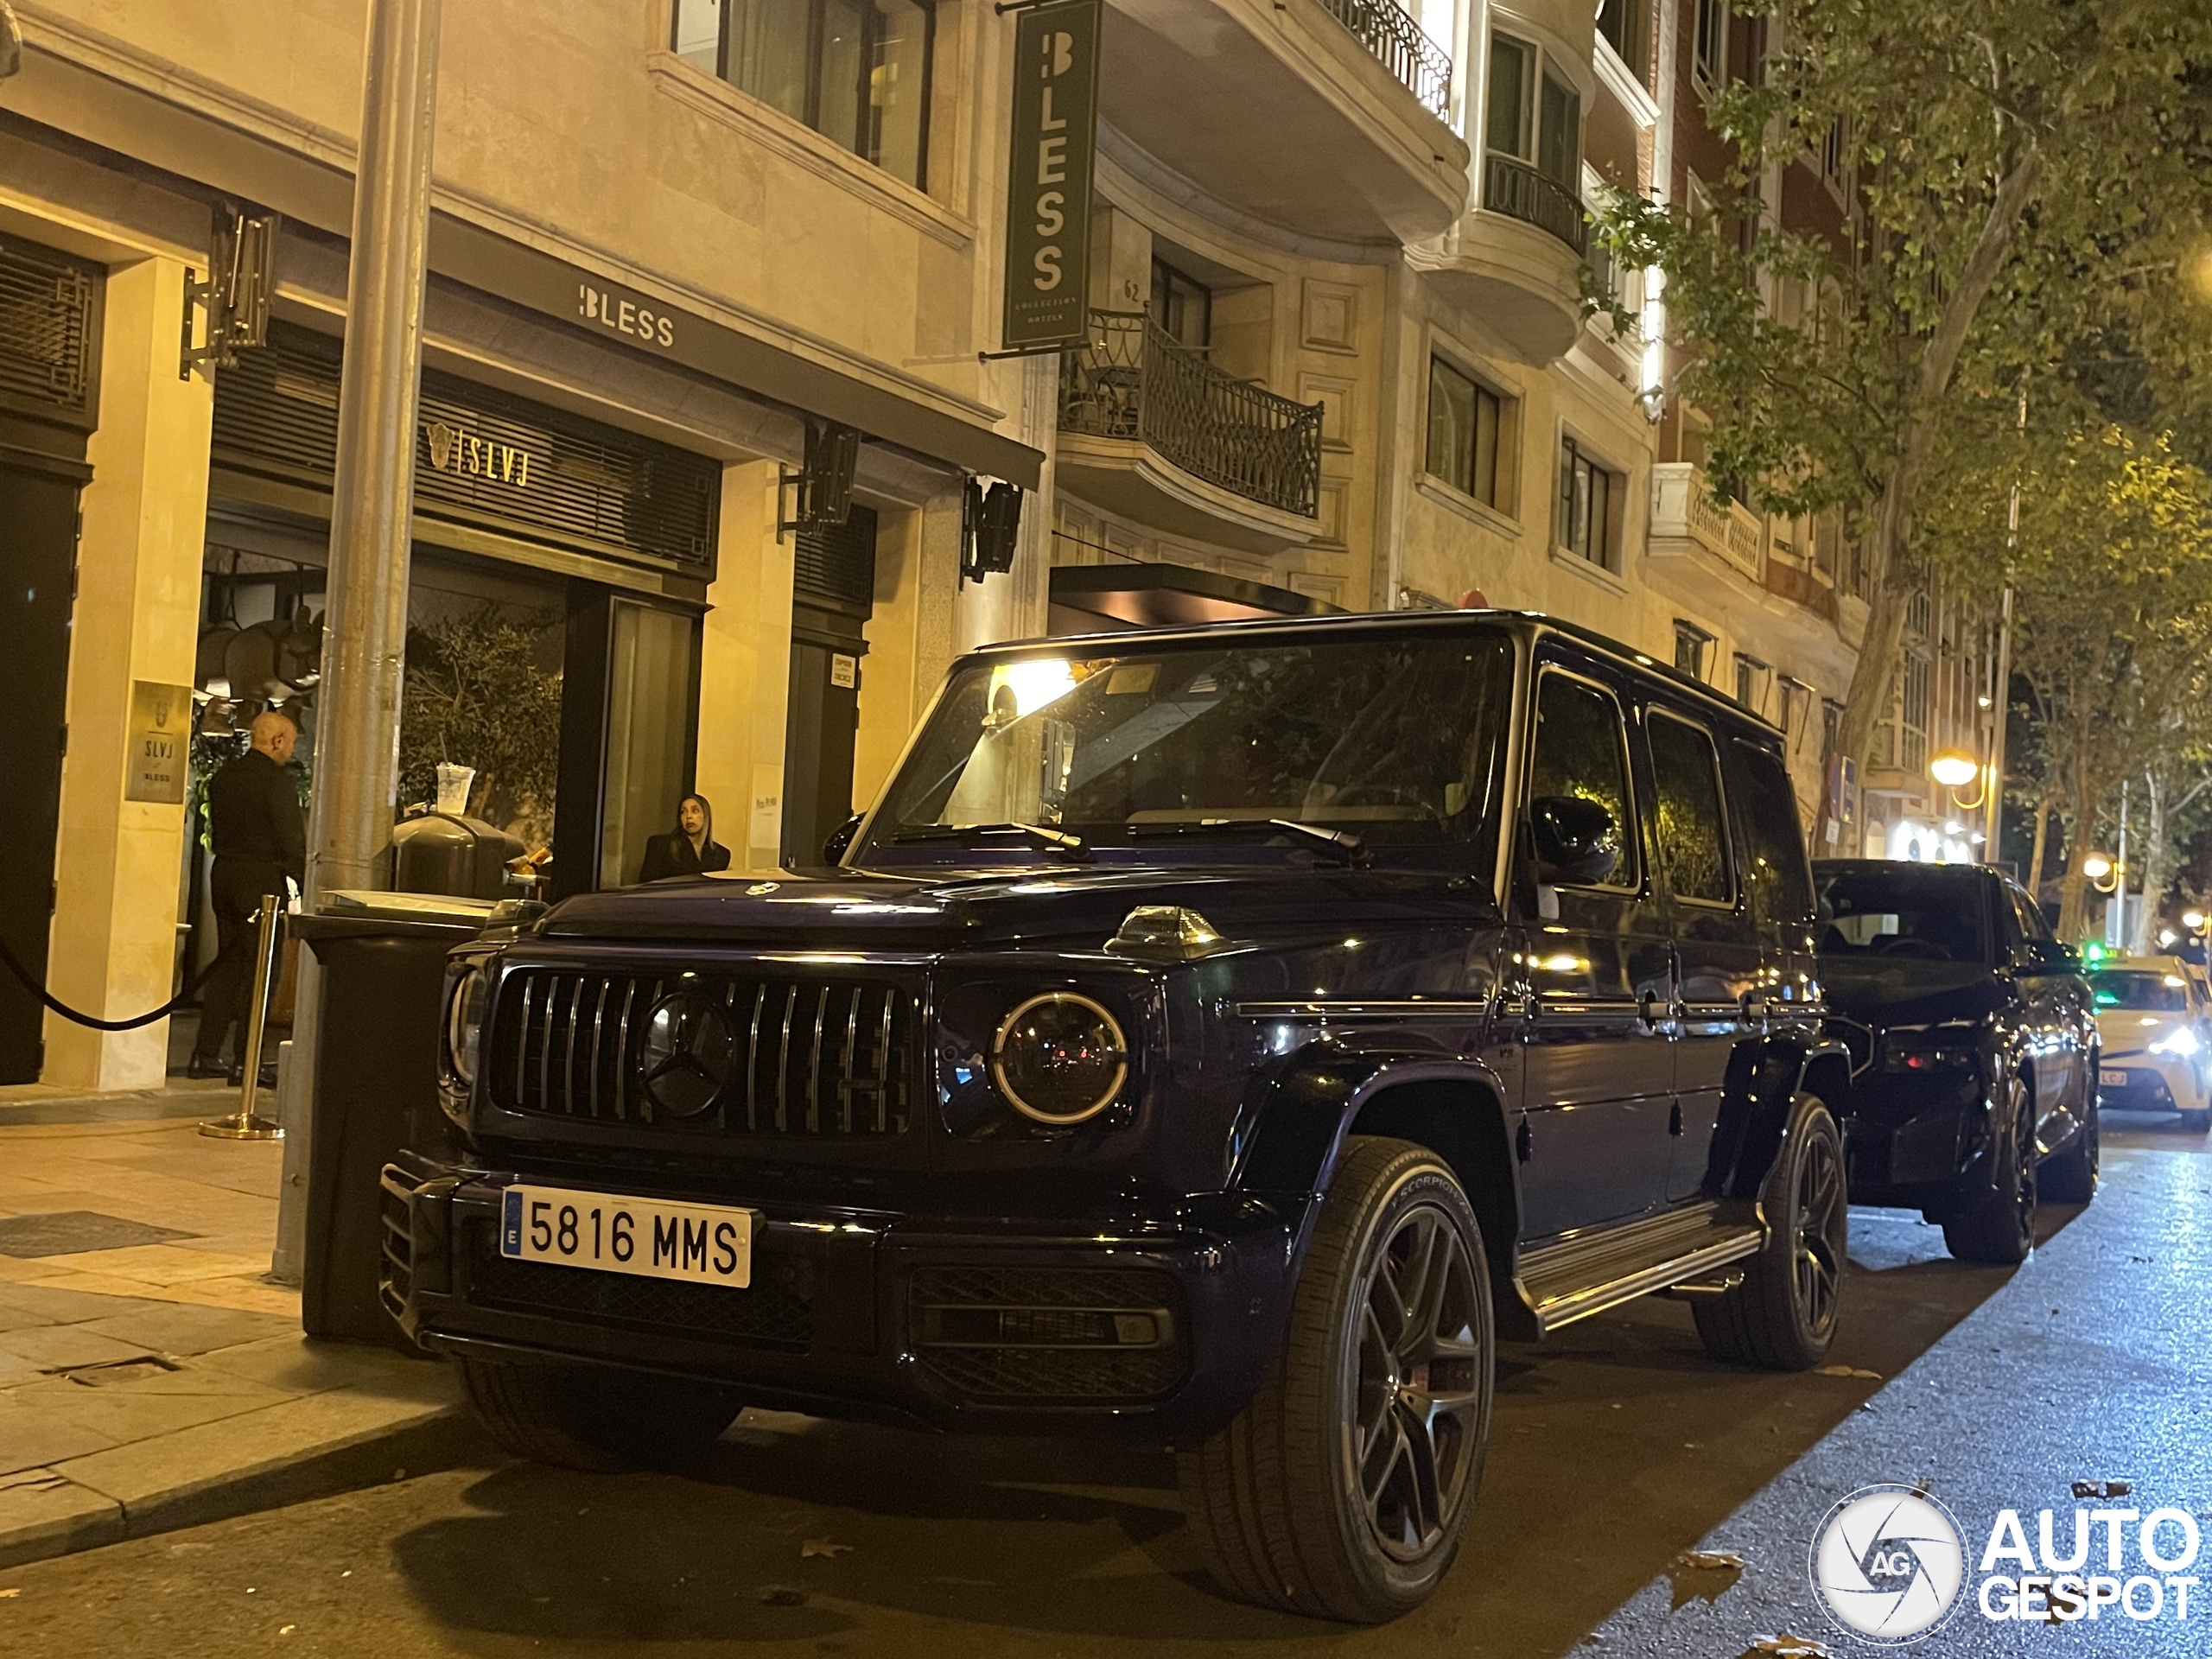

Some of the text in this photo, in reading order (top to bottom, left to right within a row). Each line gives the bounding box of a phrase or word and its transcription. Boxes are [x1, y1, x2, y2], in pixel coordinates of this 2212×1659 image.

[1033, 31, 1073, 291] BLESS
[579, 284, 673, 347] BLESS
[468, 437, 528, 486] SLVJ
[145, 740, 173, 759] SLVJ
[507, 1201, 737, 1275] E 5816 MMS
